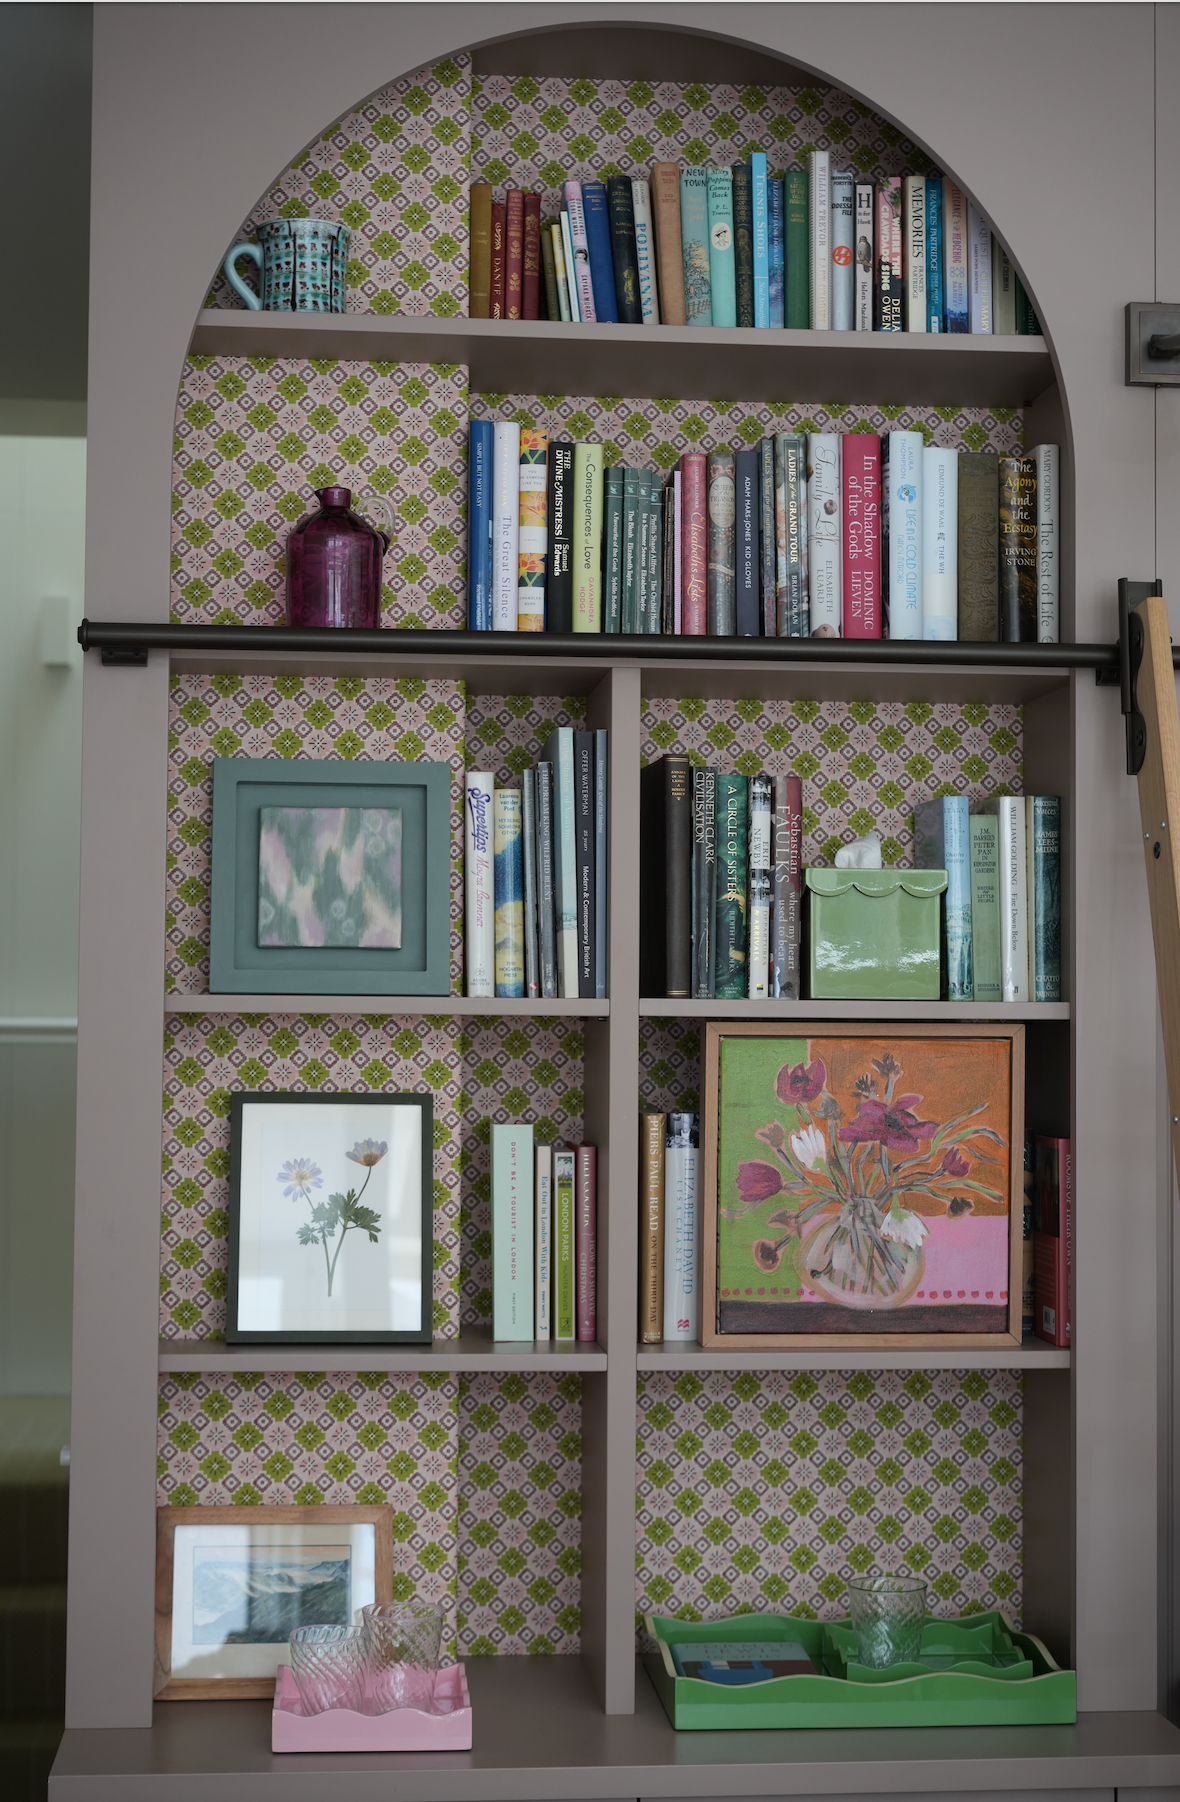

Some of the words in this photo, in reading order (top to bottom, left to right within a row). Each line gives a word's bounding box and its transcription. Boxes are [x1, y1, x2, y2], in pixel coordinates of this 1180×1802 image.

[756, 172, 766, 216] TENNIS
[858, 193, 870, 208] H
[576, 198, 585, 235] CONVENIENCE
[912, 186, 924, 258] MEMORIES
[757, 221, 766, 258] SHOES
[881, 205, 889, 263] CRAWDADS
[892, 216, 900, 253] WHERE
[494, 257, 502, 296] DANTE
[636, 223, 652, 317] POLLYANNA
[882, 264, 890, 290] SING
[892, 256, 900, 276] THE
[892, 298, 900, 332] DELIA
[864, 455, 876, 471] In
[1010, 462, 1033, 473] The
[583, 464, 595, 537] Consequences
[848, 476, 862, 493] of
[864, 476, 877, 497] the
[1004, 476, 1037, 493] Agony
[1010, 494, 1034, 506] and
[554, 482, 563, 536] MISTRESS
[789, 501, 798, 534] GRAND
[849, 494, 862, 516] the
[905, 509, 917, 527] LIFE
[1012, 507, 1031, 520] the
[502, 516, 512, 536] The
[691, 512, 705, 573] Elisabeth's
[849, 522, 862, 559] Gods
[864, 503, 877, 559] Shadow
[1003, 523, 1037, 540] Ecstasy
[1041, 519, 1053, 546] The
[502, 541, 512, 571] Great
[584, 546, 593, 569] Love
[906, 544, 917, 569] COLD
[1041, 551, 1053, 578] Rest
[501, 577, 512, 618] Silence
[687, 575, 705, 602] Lists
[852, 571, 861, 618] LIEVEN
[864, 571, 874, 630] DOMINIC
[906, 572, 917, 609] CLIMATE
[1041, 584, 1054, 597] of
[1041, 602, 1054, 627] Life
[705, 772, 714, 825] KENNETH
[728, 786, 737, 794] A
[468, 787, 491, 853] Supertips
[696, 772, 704, 843] CIVILISATION
[727, 799, 737, 837] CIRCLE
[705, 827, 714, 863] CLARK
[728, 841, 737, 856] OF
[753, 828, 761, 865] NEWBY
[775, 805, 789, 883] FAULKS
[790, 813, 801, 874] Sebastian
[471, 855, 489, 886] Moyra
[728, 860, 737, 902] SISTERS
[476, 888, 490, 928] Bremner
[582, 900, 590, 945] Contemporary
[778, 926, 785, 936] to
[786, 925, 795, 939] my
[778, 940, 786, 961] beat
[788, 943, 797, 970] heart
[650, 1120, 658, 1155] PIERS
[511, 1171, 516, 1181] BE
[649, 1161, 658, 1191] PAUL
[649, 1197, 658, 1231] READ
[684, 1158, 694, 1241] ELIZABETH
[589, 1265, 595, 1277] TO
[682, 1248, 693, 1294] DAVID
